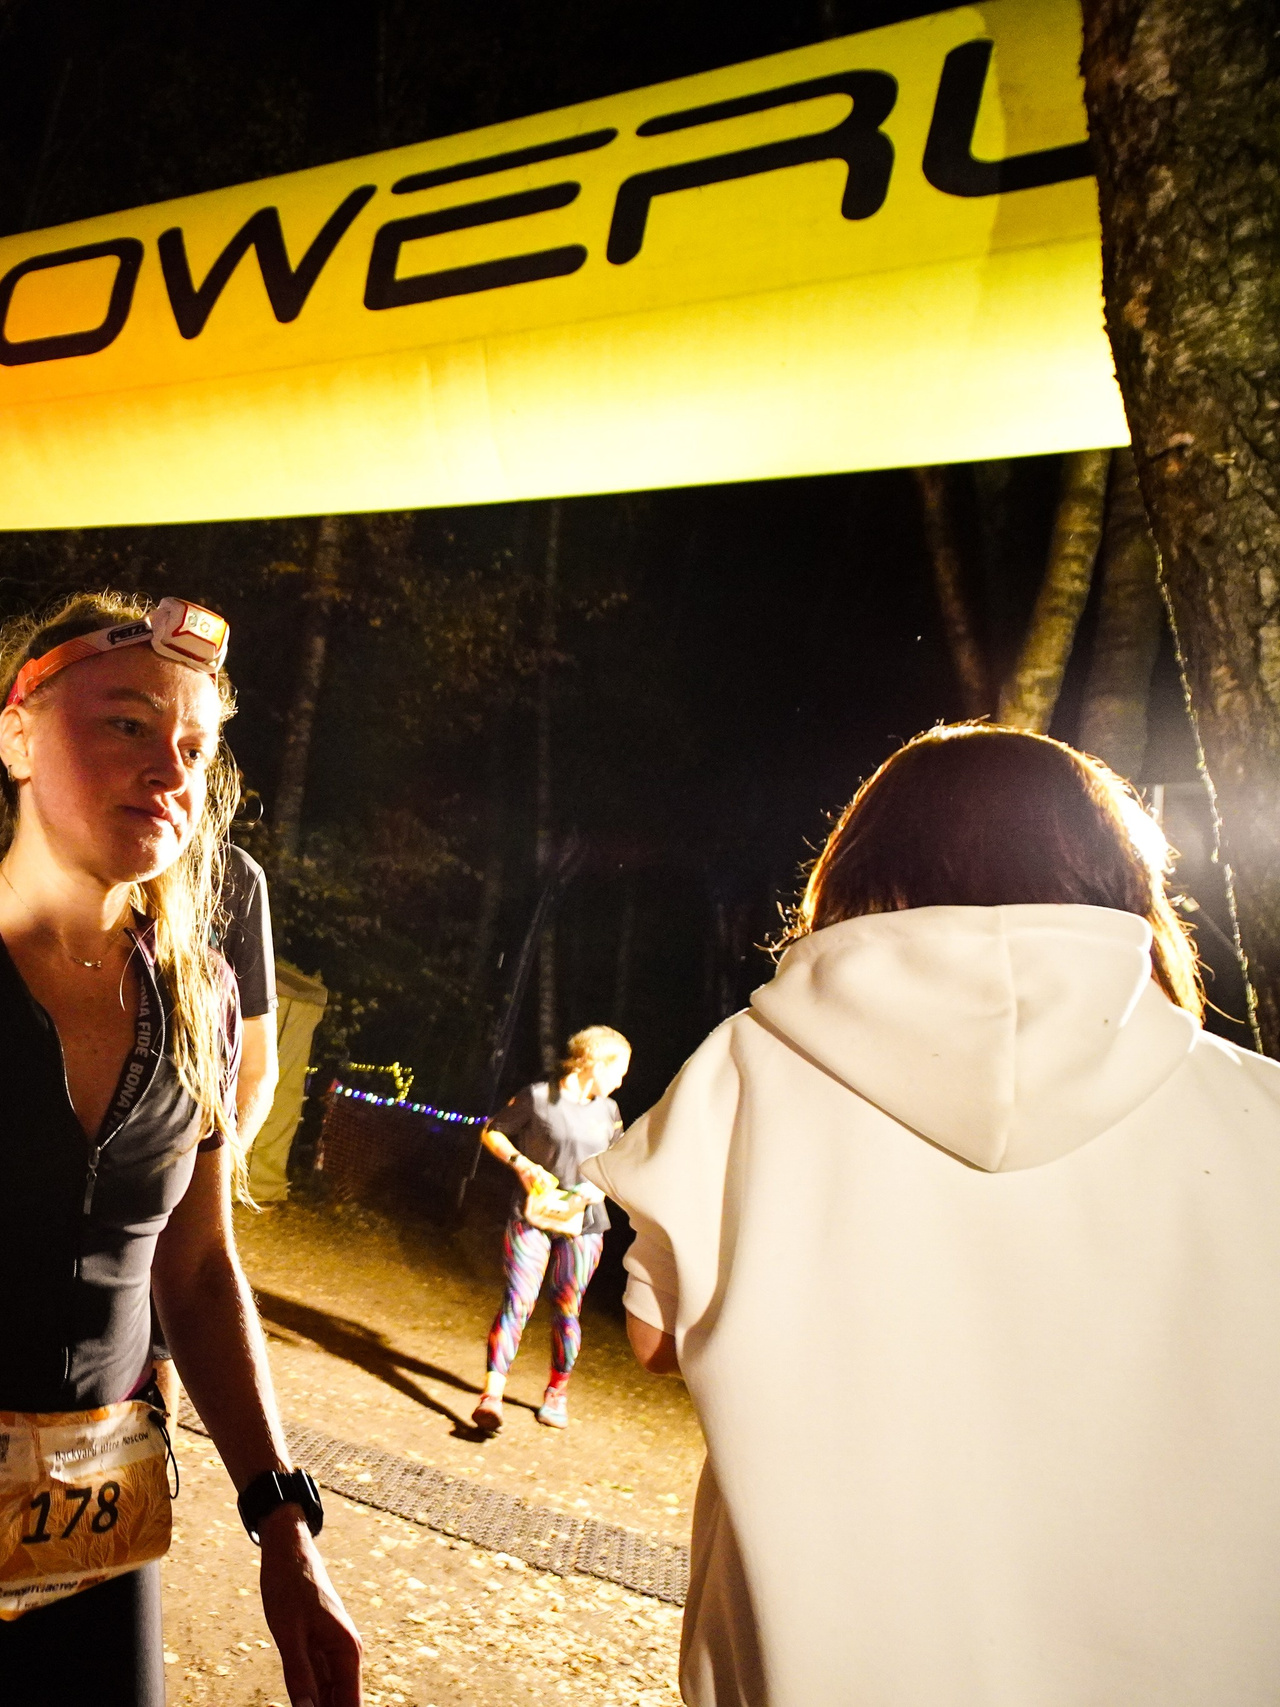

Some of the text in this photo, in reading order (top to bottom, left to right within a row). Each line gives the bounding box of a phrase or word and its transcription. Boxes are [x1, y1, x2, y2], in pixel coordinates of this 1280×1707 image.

[134, 1021, 152, 1058] FIDE
[116, 1062, 144, 1111] BONA
[55, 1444, 97, 1462] Backyard
[122, 1432, 149, 1446] Moscow
[21, 1480, 121, 1545] 178
